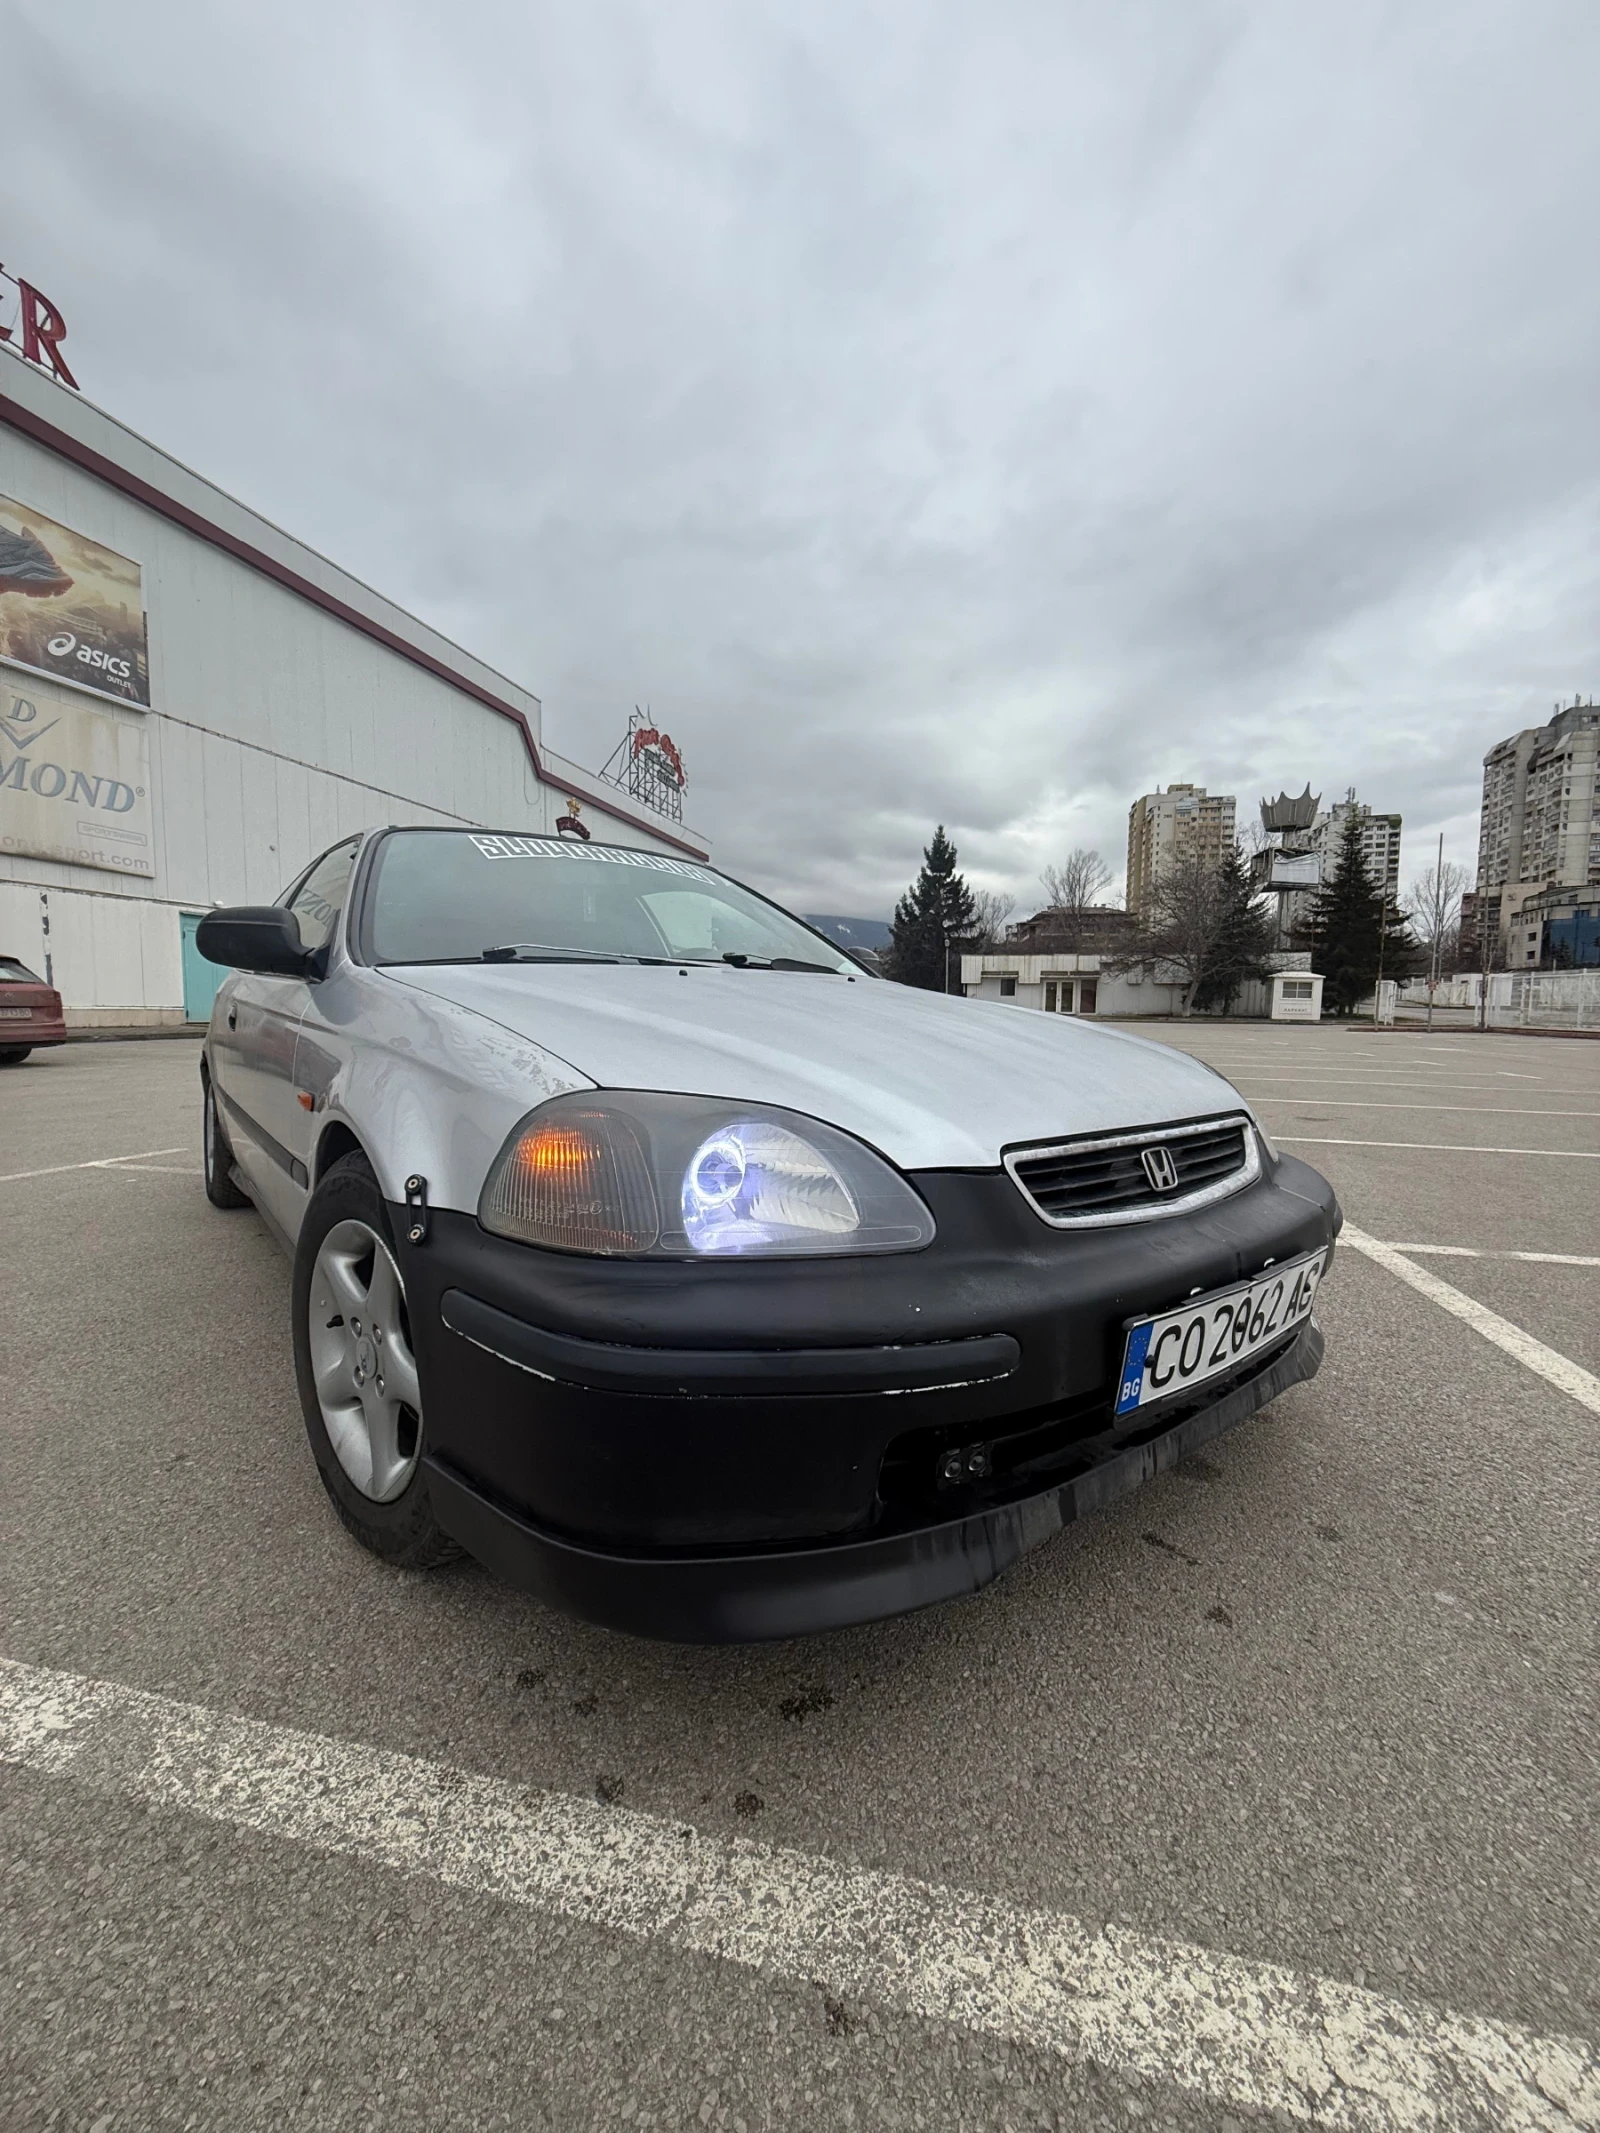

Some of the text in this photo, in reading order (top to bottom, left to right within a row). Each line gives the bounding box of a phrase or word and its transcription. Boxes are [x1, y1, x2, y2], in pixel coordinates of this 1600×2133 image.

[106, 675, 131, 688] OUTLET
[6, 695, 37, 723] D
[1121, 1377, 1141, 1402] BG
